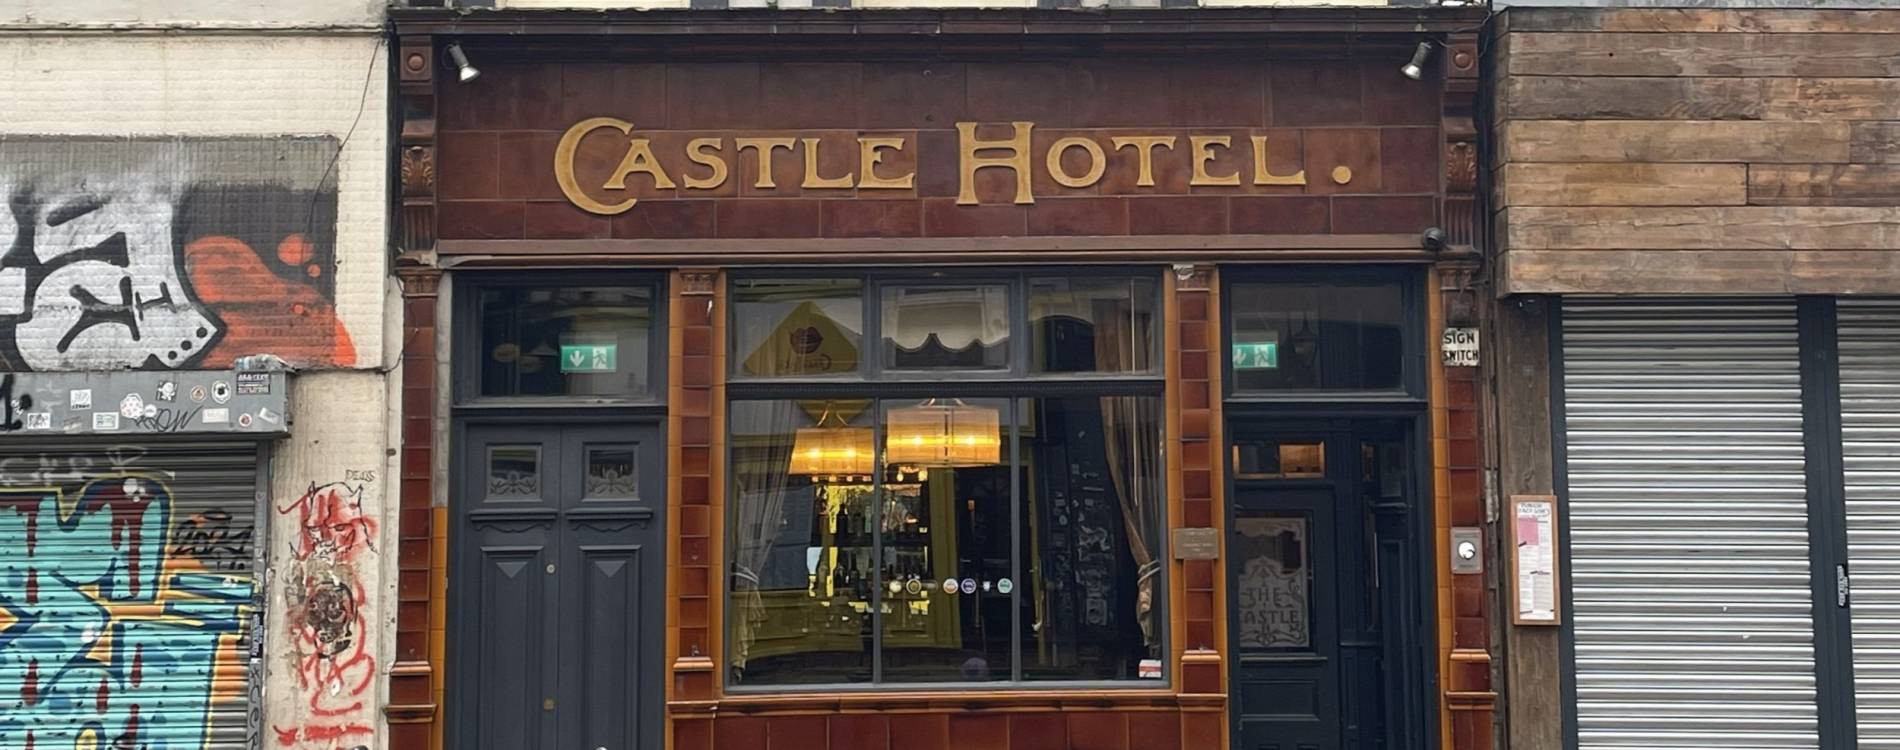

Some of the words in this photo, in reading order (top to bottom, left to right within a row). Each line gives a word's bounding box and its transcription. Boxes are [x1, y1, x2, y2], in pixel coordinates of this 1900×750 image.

[554, 117, 915, 215] CASTLE
[1444, 333, 1475, 344] SIGN
[1442, 350, 1479, 361] SWITCH
[1245, 587, 1283, 608] THE
[1240, 609, 1299, 625] ASTLE
